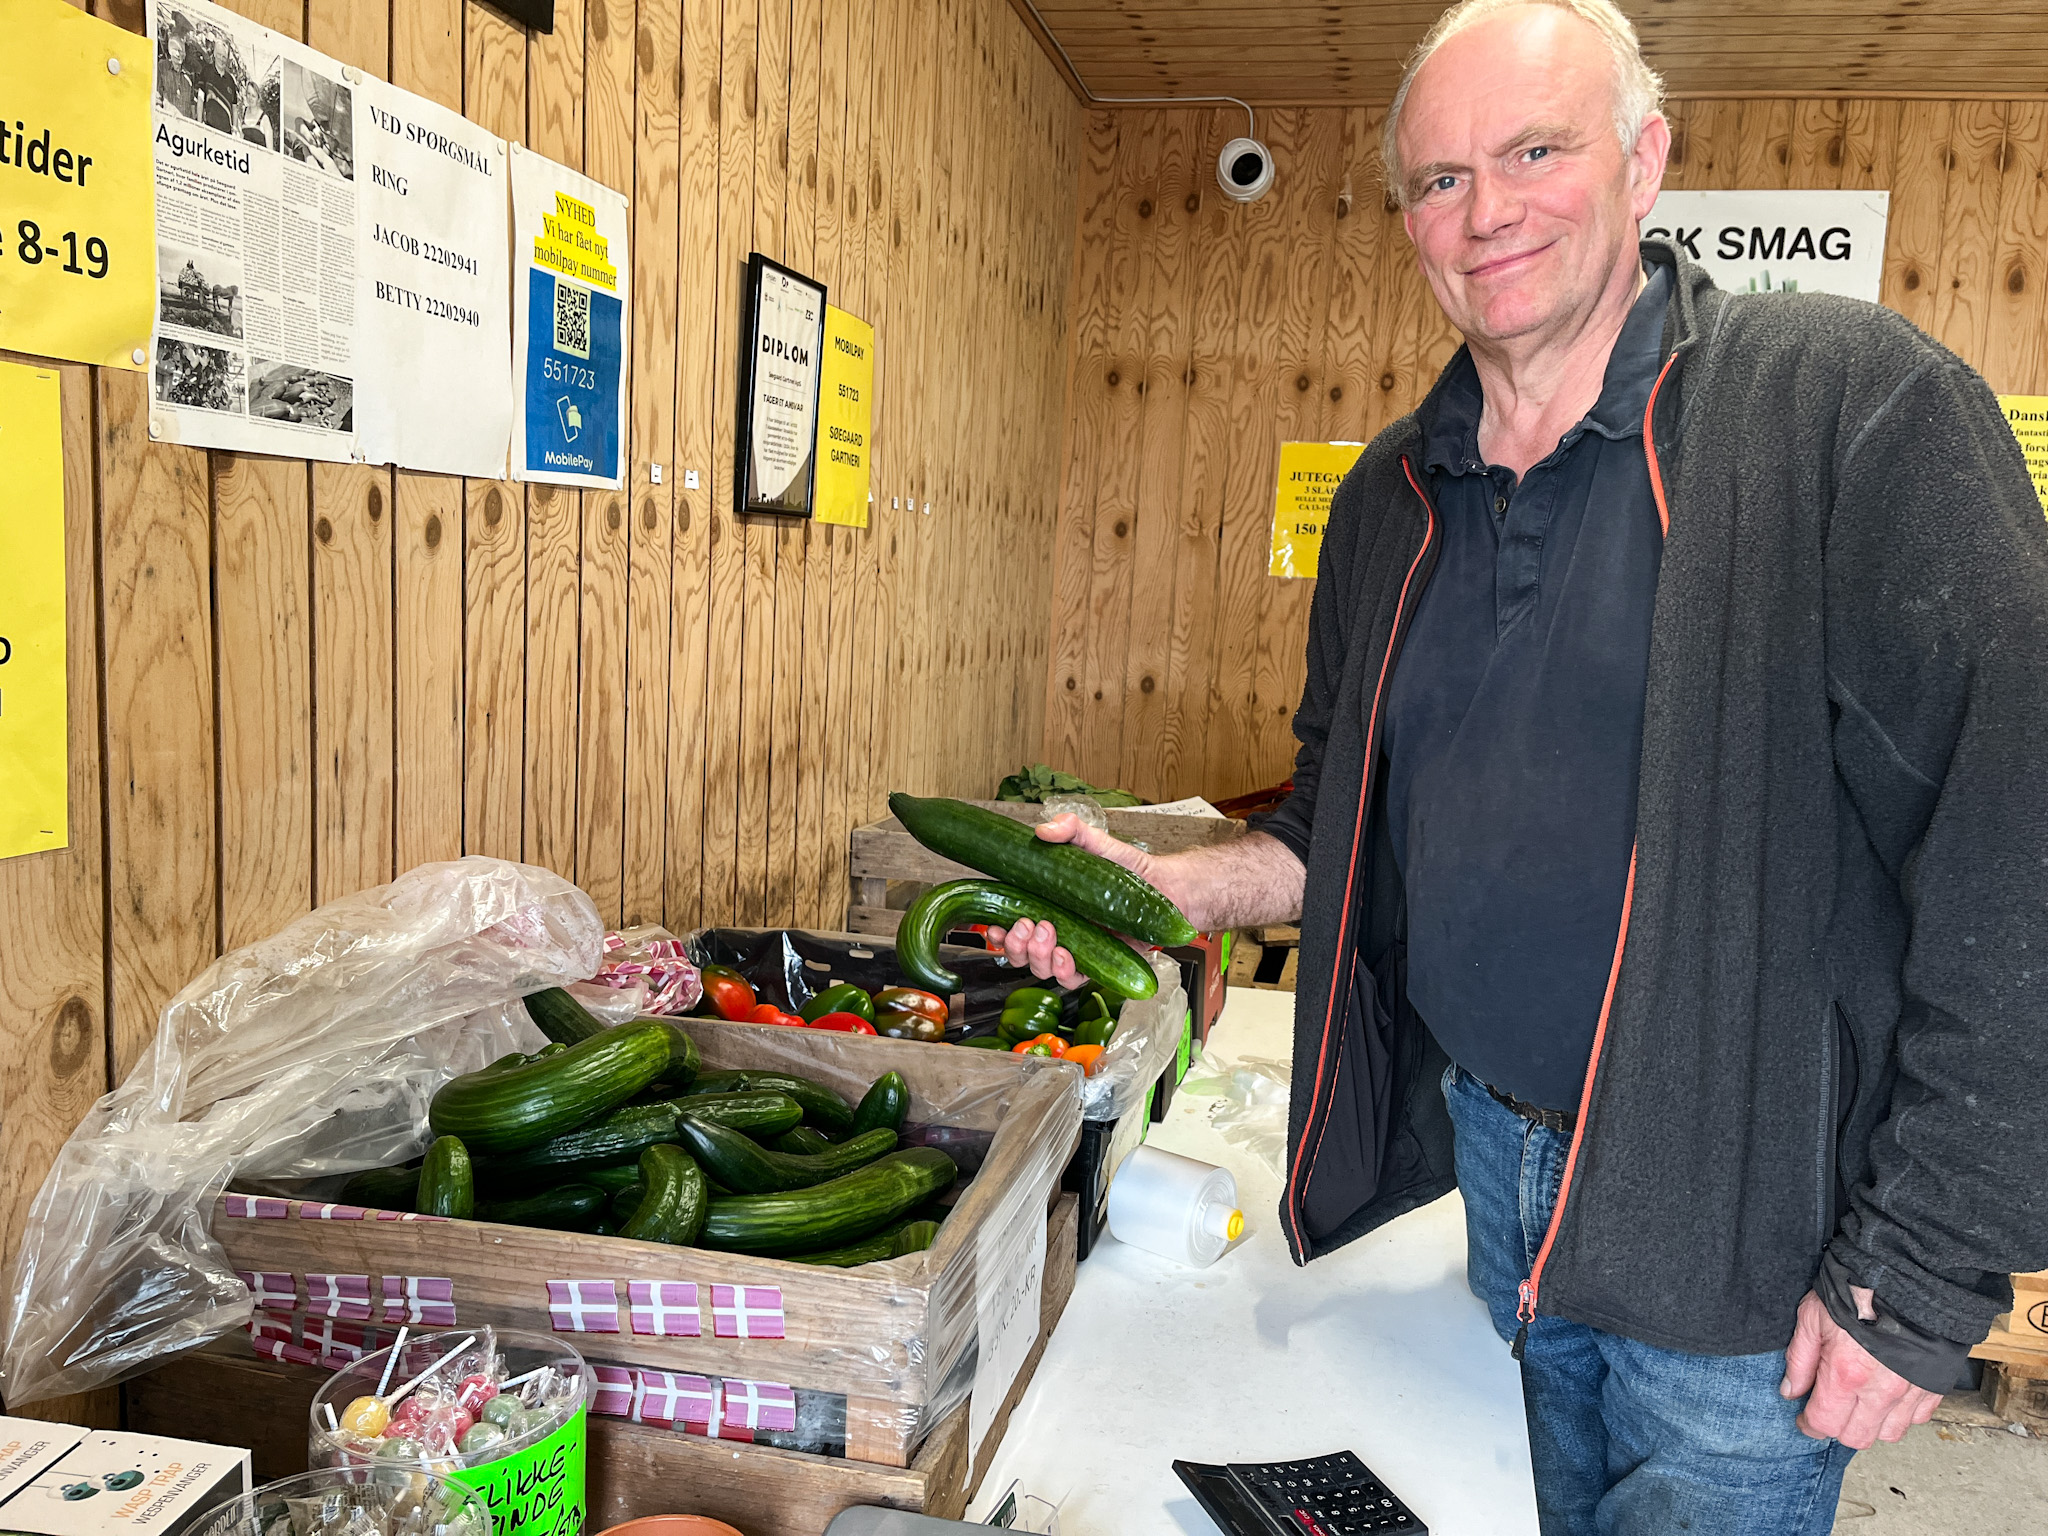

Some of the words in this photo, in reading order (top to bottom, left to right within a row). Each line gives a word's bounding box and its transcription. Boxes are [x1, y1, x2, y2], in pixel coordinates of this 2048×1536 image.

[156, 123, 250, 175] Agurketid
[370, 105, 401, 135] VED
[406, 123, 492, 176] SPØRGSMÅL
[372, 164, 408, 196] RING
[556, 195, 596, 227] NYHED
[18, 219, 109, 279] 8-19
[373, 223, 420, 256] JACOB
[424, 242, 478, 276] 22202941
[543, 217, 555, 238] Vi
[558, 223, 574, 244] har
[576, 231, 592, 252] fået
[595, 243, 608, 261] nyt
[1717, 226, 1852, 261] SMAG
[534, 246, 578, 277] mobilpay
[581, 264, 617, 286] nummer
[375, 280, 422, 311] BETTY
[426, 297, 479, 328] 22202940
[762, 335, 808, 367] DIPLOM
[835, 336, 864, 360] MOBILPAY
[543, 357, 596, 390] 551723
[838, 384, 859, 402] 551723
[830, 426, 863, 447] SØEGAARD
[545, 451, 594, 472] MobilePay
[831, 449, 860, 468] GARTNERI
[1295, 523, 1316, 535] 150
[110, 1488, 155, 1518] WASP
[147, 1462, 184, 1488] TRAP
[132, 1462, 212, 1525] WESPENVANGER
